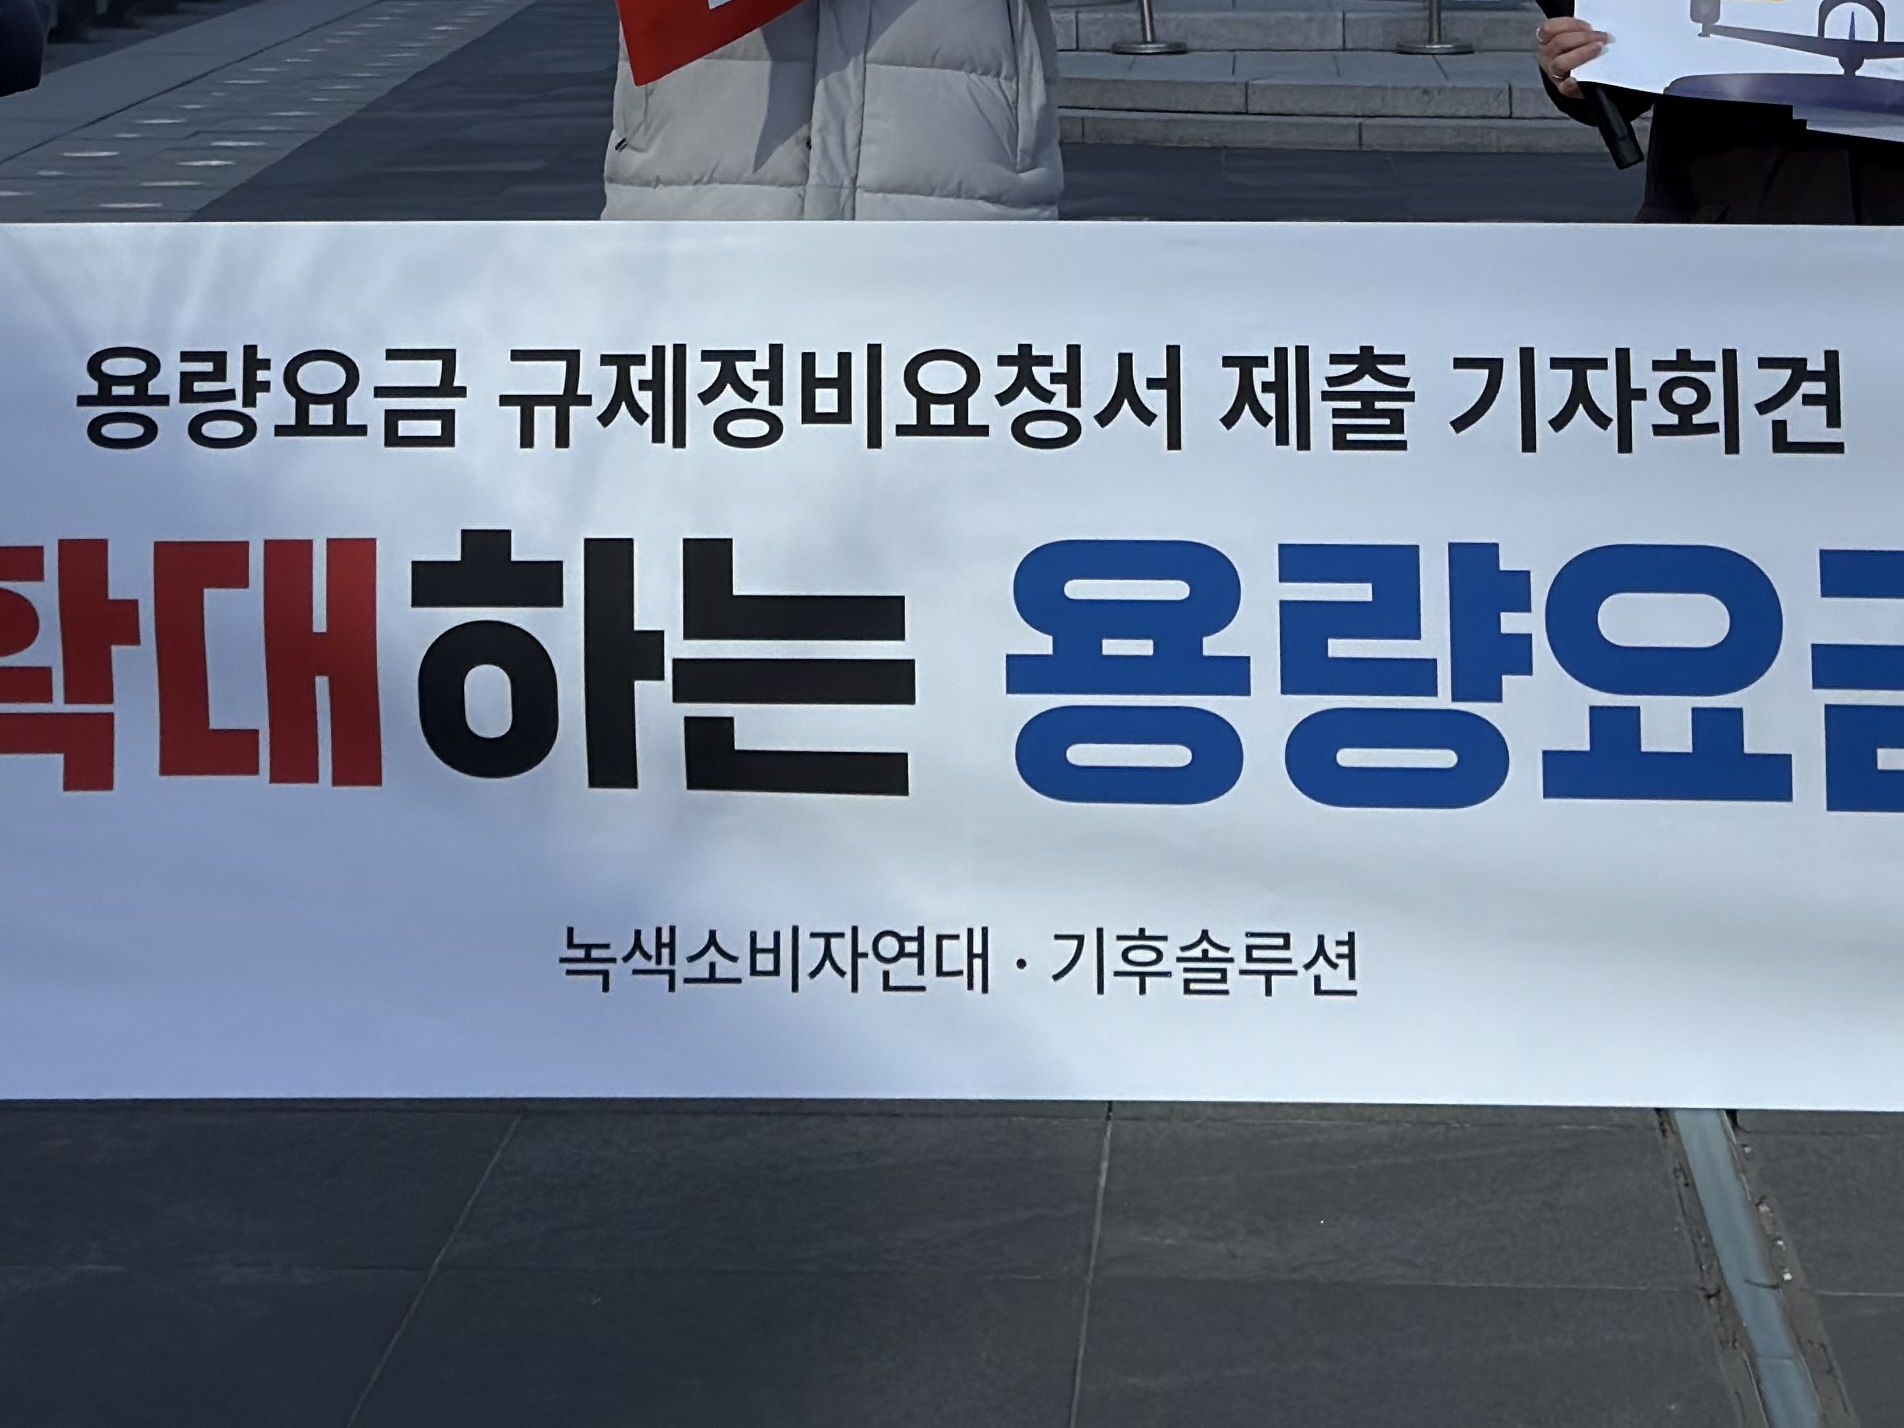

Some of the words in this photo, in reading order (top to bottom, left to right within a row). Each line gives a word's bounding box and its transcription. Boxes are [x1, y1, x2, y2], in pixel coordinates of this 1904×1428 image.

[76, 344, 468, 450] 용량요금
[498, 343, 1182, 451] 규제정비요청서
[1219, 345, 1416, 451] 제출
[1449, 346, 1845, 455] 기자회견
[558, 924, 989, 995] 녹색소비자연대
[1051, 927, 1358, 997] 기후솔루션
